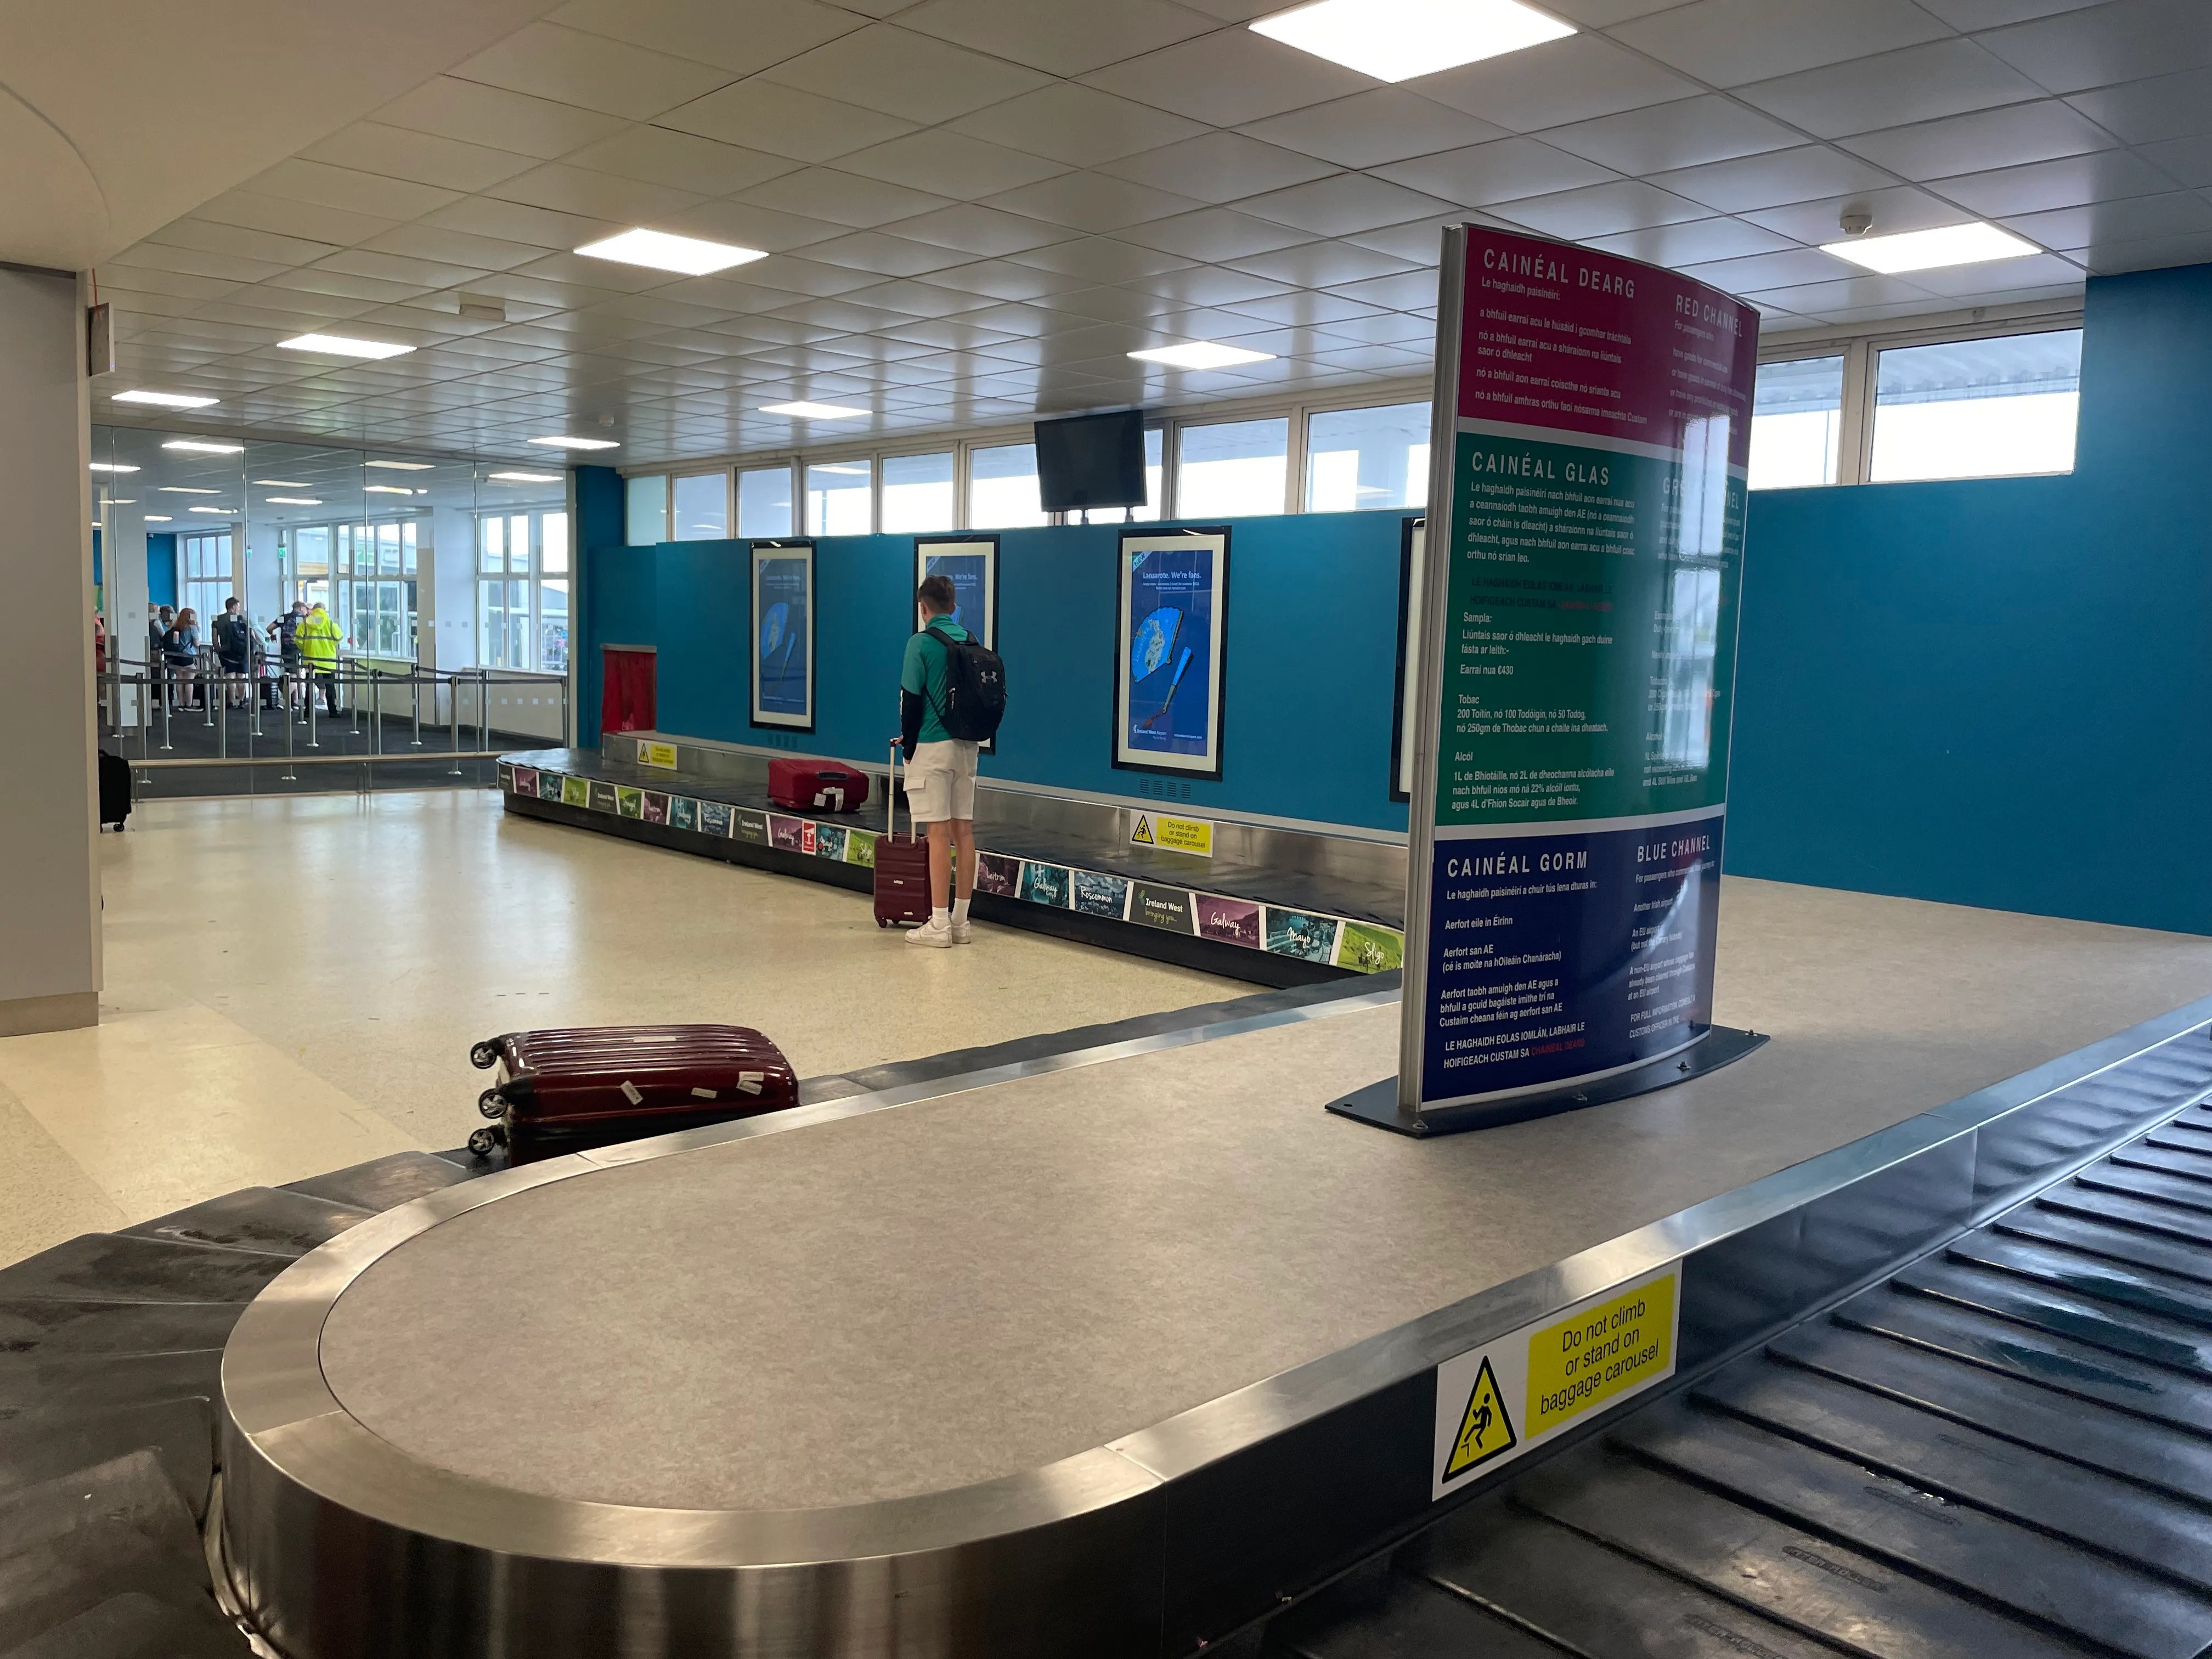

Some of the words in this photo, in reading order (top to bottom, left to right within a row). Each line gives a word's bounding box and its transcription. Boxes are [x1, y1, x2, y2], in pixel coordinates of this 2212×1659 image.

[1483, 248, 1568, 284] CAINÉAL
[1578, 267, 1635, 298] DEARG
[1675, 294, 1699, 317] RED
[1703, 304, 1742, 338] CHANNEL
[1472, 451, 1555, 479] CAINÉAL
[1565, 462, 1609, 486] GLAS
[1161, 836, 1182, 845] baggage
[1637, 842, 1667, 862] BLUE
[1671, 834, 1710, 857] CHANNEL
[1447, 851, 1530, 877] CAINÉAL
[1540, 851, 1587, 872] GORM
[1034, 878, 1058, 898] Galway
[1080, 885, 1113, 904] Roscommon
[1447, 890, 1456, 900] Le
[1457, 887, 1489, 901] haghaidh
[1491, 885, 1522, 899] paisinéirí
[1528, 884, 1545, 894] chuir
[1545, 883, 1556, 893] tús
[1556, 882, 1570, 892] lena
[1146, 899, 1167, 911] Ireland
[1167, 902, 1183, 913] West
[1210, 911, 1241, 935] Galway
[1444, 918, 1470, 930] Aerfort
[1471, 917, 1483, 928] eile
[1485, 917, 1492, 927] in
[1493, 914, 1513, 926] Éirinn
[1286, 926, 1311, 949] Mayo
[1364, 941, 1385, 964] Sligo
[1443, 946, 1468, 958] Aerfort
[1469, 947, 1482, 955] san
[1483, 944, 1494, 954] AE
[1442, 961, 1454, 974] (cé
[1463, 959, 1483, 970] moite
[1494, 955, 1521, 967] hOileáin
[1441, 988, 1466, 1000] Aerfort
[1467, 985, 1487, 997] taobh
[1488, 983, 1513, 995] amuigh
[1527, 979, 1537, 990] AE
[1439, 1015, 1469, 1027] Custaim
[1470, 1013, 1494, 1024] cheana
[1496, 1010, 1509, 1020] féin
[1509, 1011, 1519, 1020] ag
[1519, 1006, 1541, 1017] aerfort
[1553, 1002, 1563, 1012] AE
[1440, 1002, 1460, 1013] bhfuil
[1468, 998, 1487, 1013] gcuid
[1488, 996, 1517, 1009] bagáiste
[1517, 993, 1538, 1004] imithe
[1445, 1040, 1455, 1051] LE
[1456, 1035, 1495, 1049] HAGHAIDH
[1496, 1032, 1520, 1045] EOLAS
[1521, 1026, 1548, 1041] IOMLÁN,
[1549, 1023, 1577, 1036] LABHAIR
[1577, 1021, 1585, 1031] LE
[1443, 1053, 1489, 1069] HOIFIGEACH
[1490, 1048, 1519, 1062] CUSTAM
[1520, 1047, 1530, 1058] SA
[1562, 1330, 1582, 1353] Do
[1586, 1315, 1607, 1341] not
[1611, 1299, 1645, 1328] climb
[1565, 1359, 1579, 1376] or
[1583, 1332, 1620, 1367] stand
[1623, 1329, 1639, 1348] on
[1540, 1371, 1601, 1415] baggage
[1605, 1338, 1659, 1381] carousel
